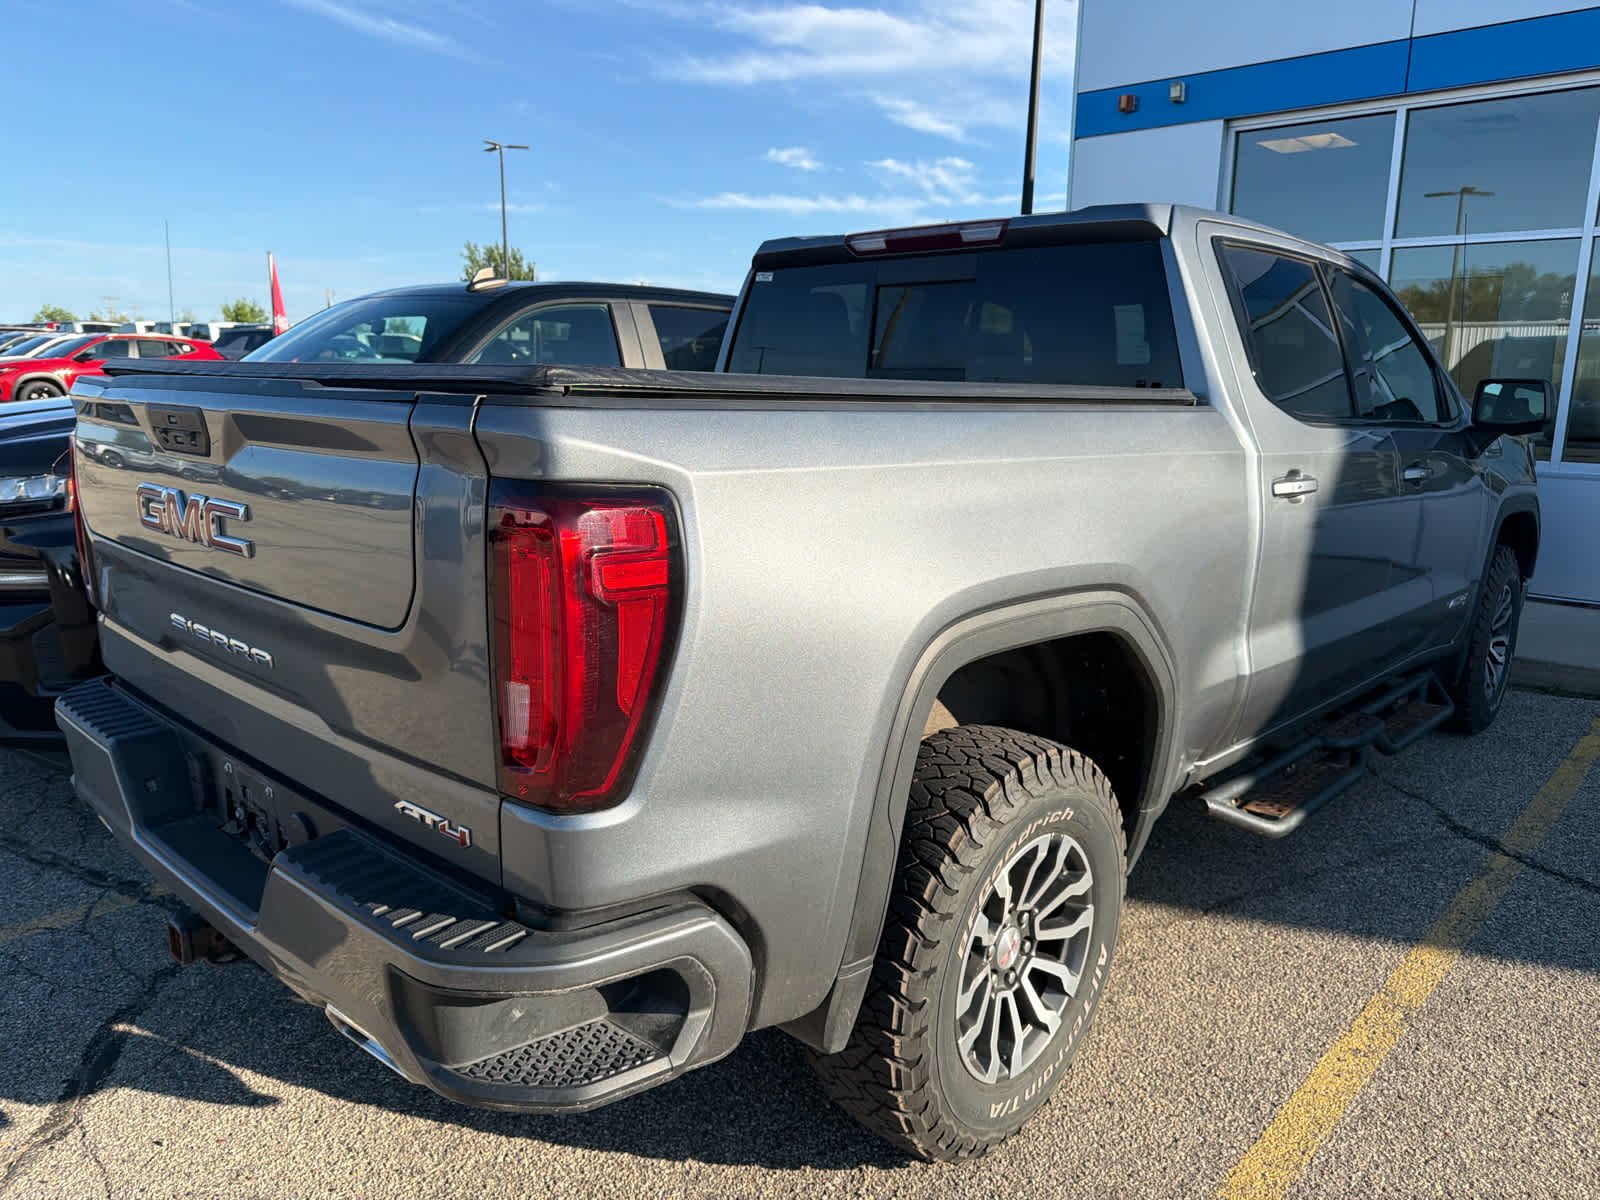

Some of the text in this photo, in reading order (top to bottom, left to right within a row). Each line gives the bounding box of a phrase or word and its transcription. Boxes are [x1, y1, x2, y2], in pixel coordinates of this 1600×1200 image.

[136, 483, 255, 559] GMC
[170, 612, 275, 669] SIERRA
[393, 800, 472, 848] AT4
